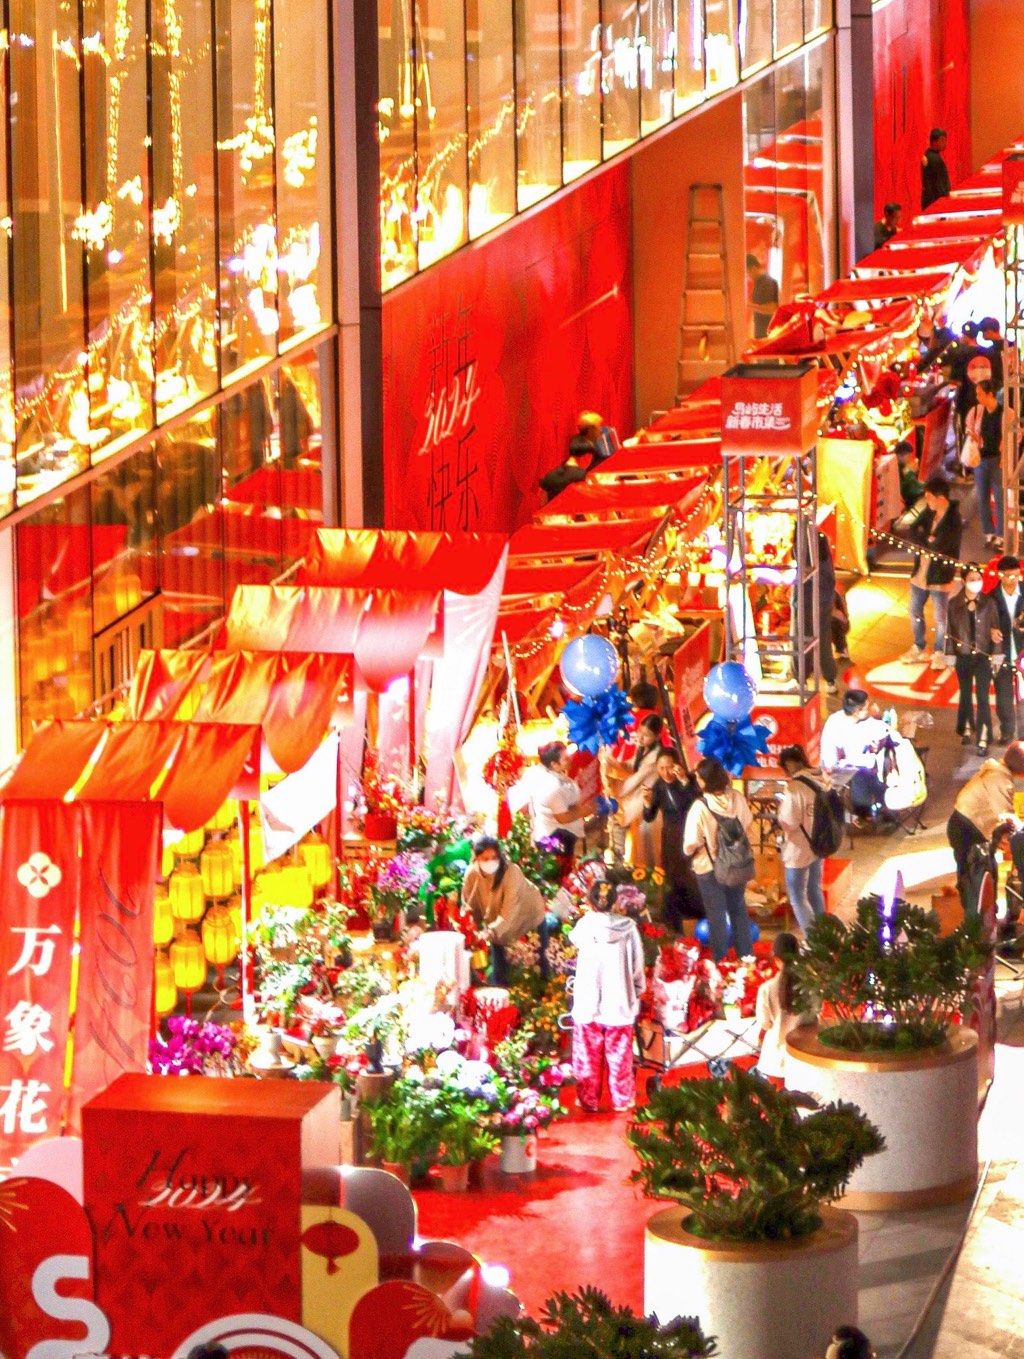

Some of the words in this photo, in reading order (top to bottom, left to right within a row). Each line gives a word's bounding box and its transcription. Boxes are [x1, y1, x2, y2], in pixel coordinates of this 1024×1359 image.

[0, 923, 62, 1180] 万象花
[201, 1218, 274, 1248] Year
